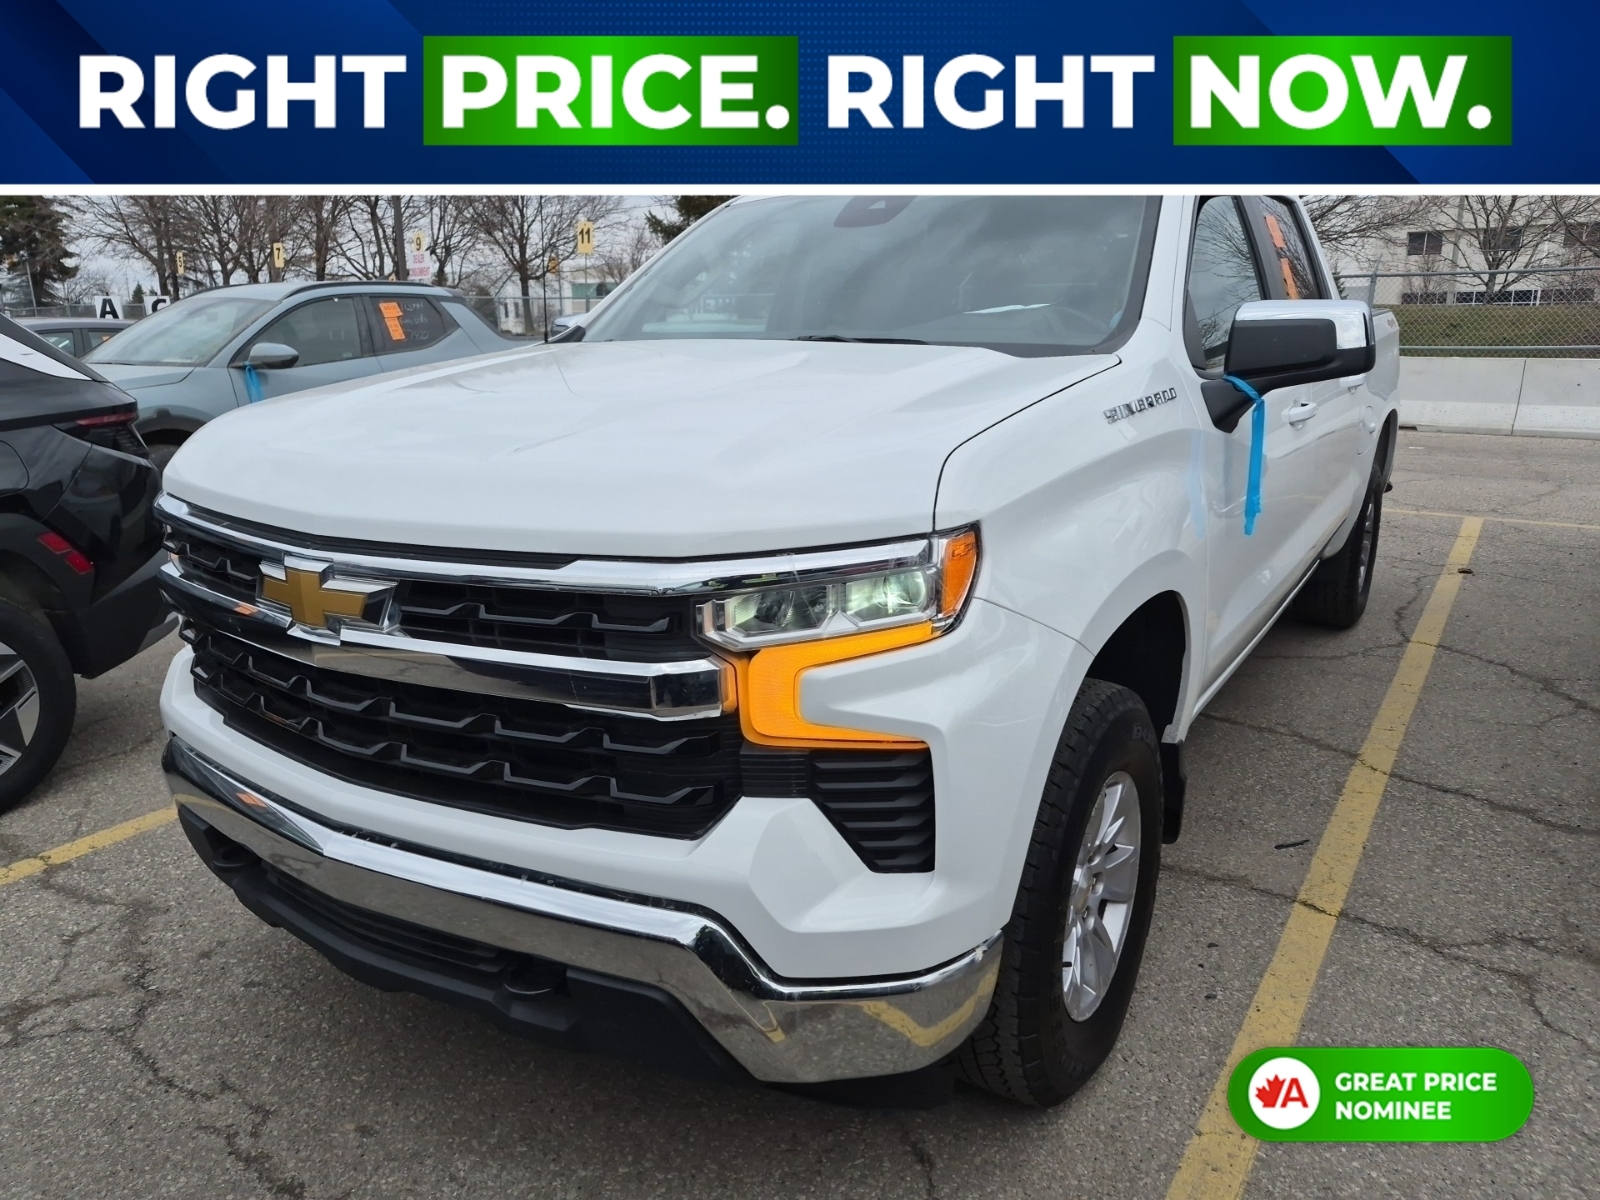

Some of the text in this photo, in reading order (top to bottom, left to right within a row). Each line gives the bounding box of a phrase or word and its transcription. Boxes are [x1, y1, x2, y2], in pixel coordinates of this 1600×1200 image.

[415, 236, 422, 251] 9
[578, 227, 590, 244] 11
[178, 256, 183, 268] 5
[276, 248, 281, 260] 7
[99, 298, 119, 319] A
[1103, 387, 1177, 424] SILVERADO
